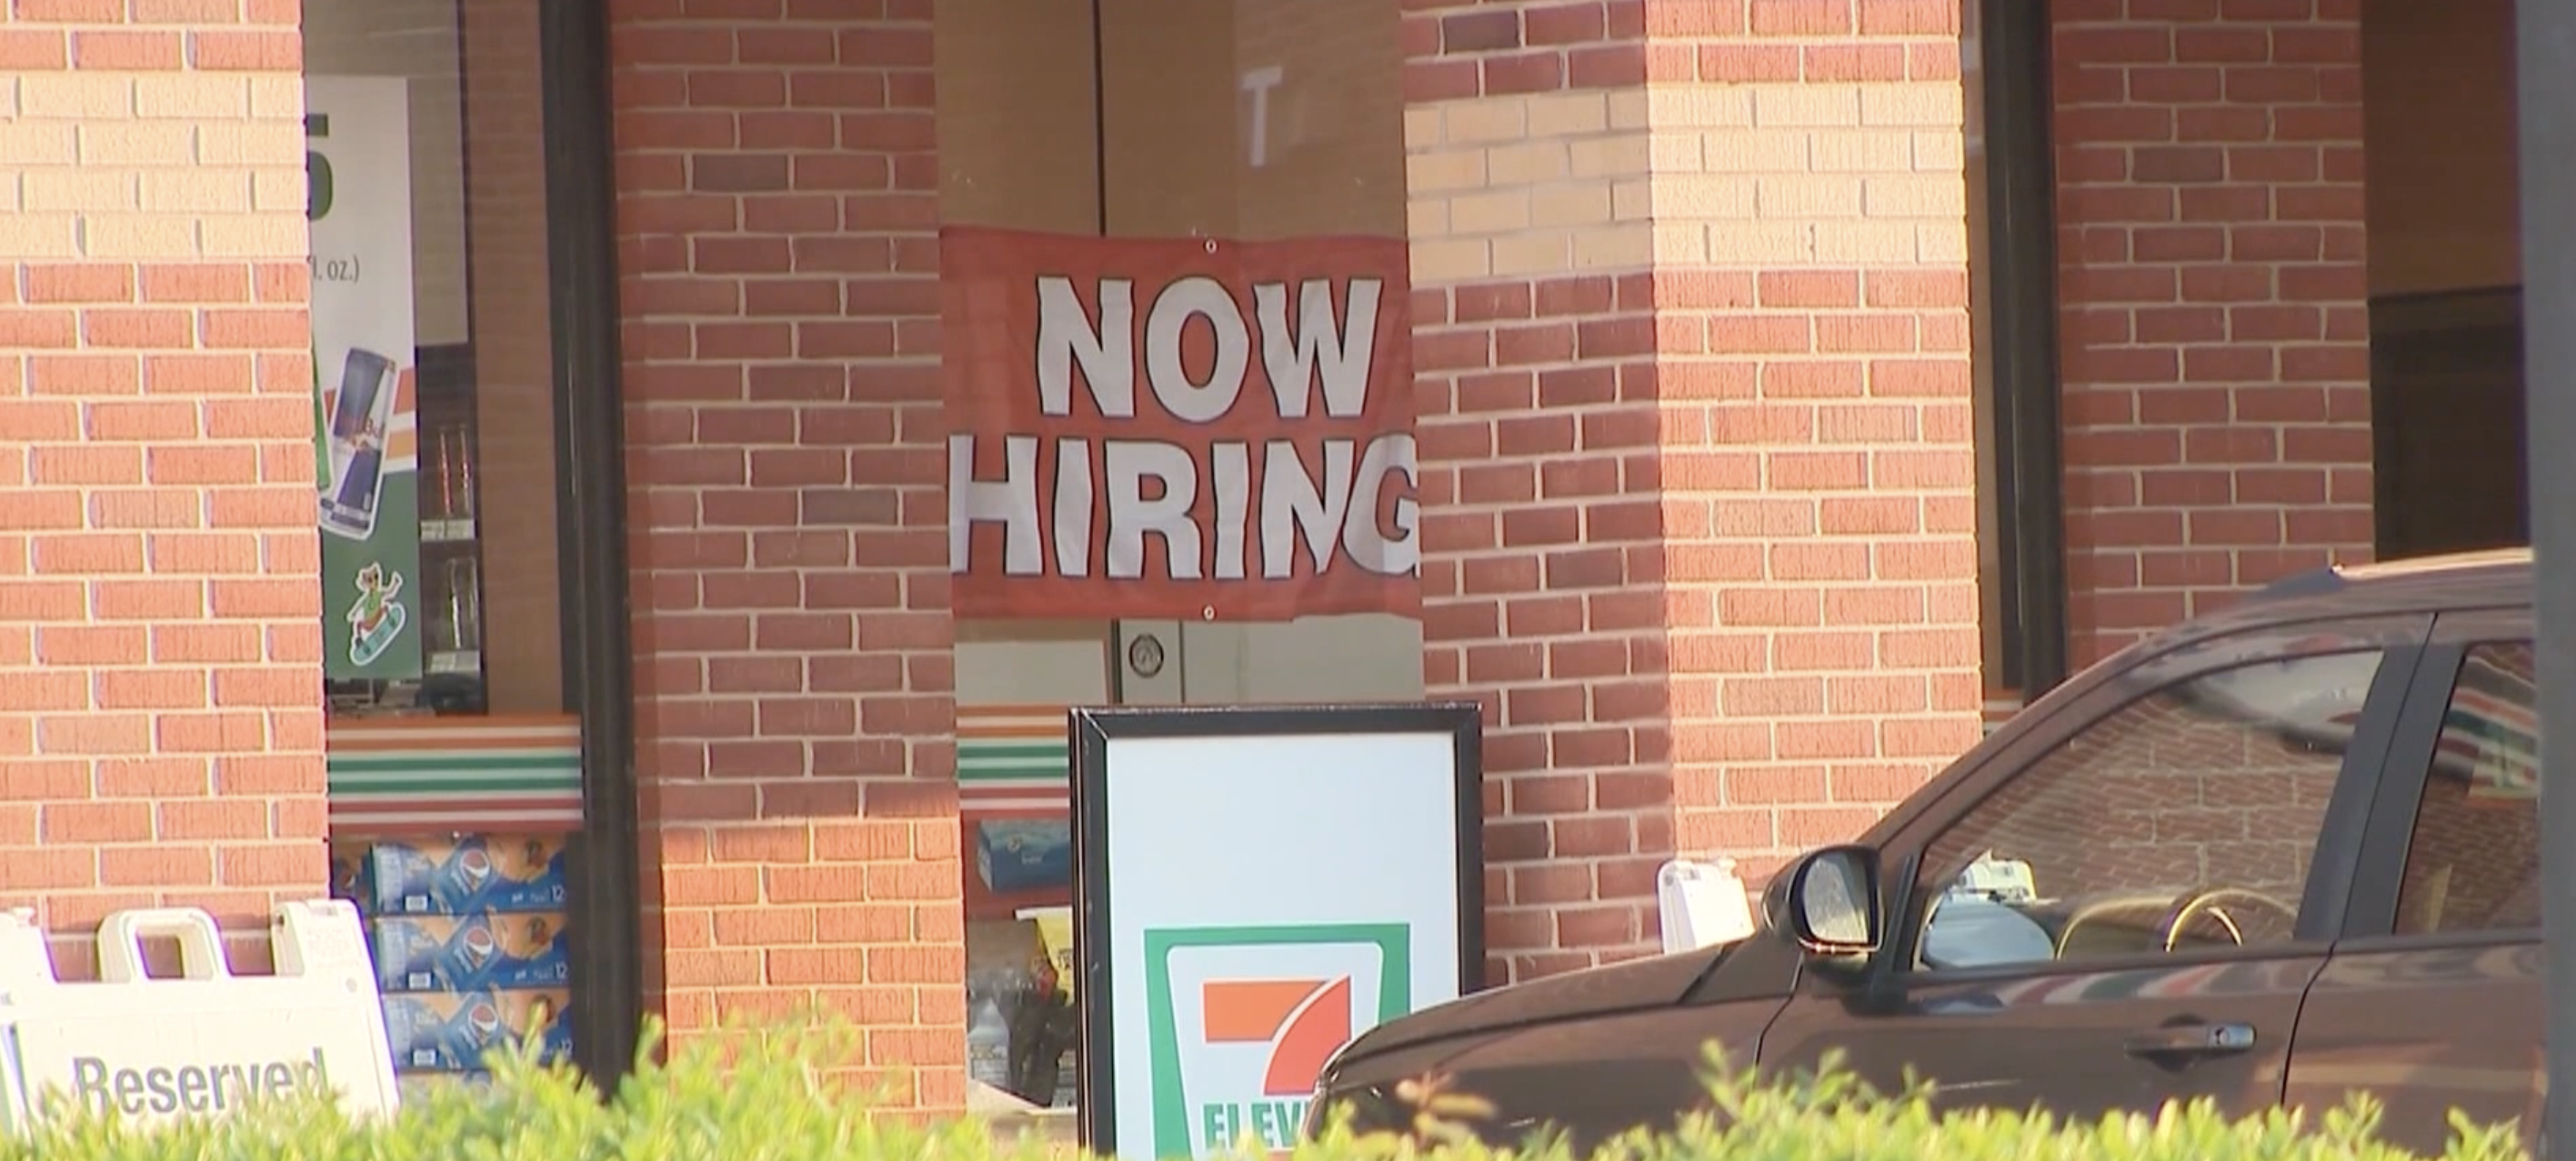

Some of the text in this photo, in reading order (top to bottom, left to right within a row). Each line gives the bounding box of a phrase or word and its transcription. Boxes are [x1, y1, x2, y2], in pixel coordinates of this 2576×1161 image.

[326, 254, 359, 284] oz.)
[1036, 275, 1383, 424] NOW
[947, 433, 1420, 580] HIRING
[73, 1046, 328, 1116] Reserved
[1202, 974, 1351, 1096] 7
[1203, 1101, 1310, 1149] ELEV
